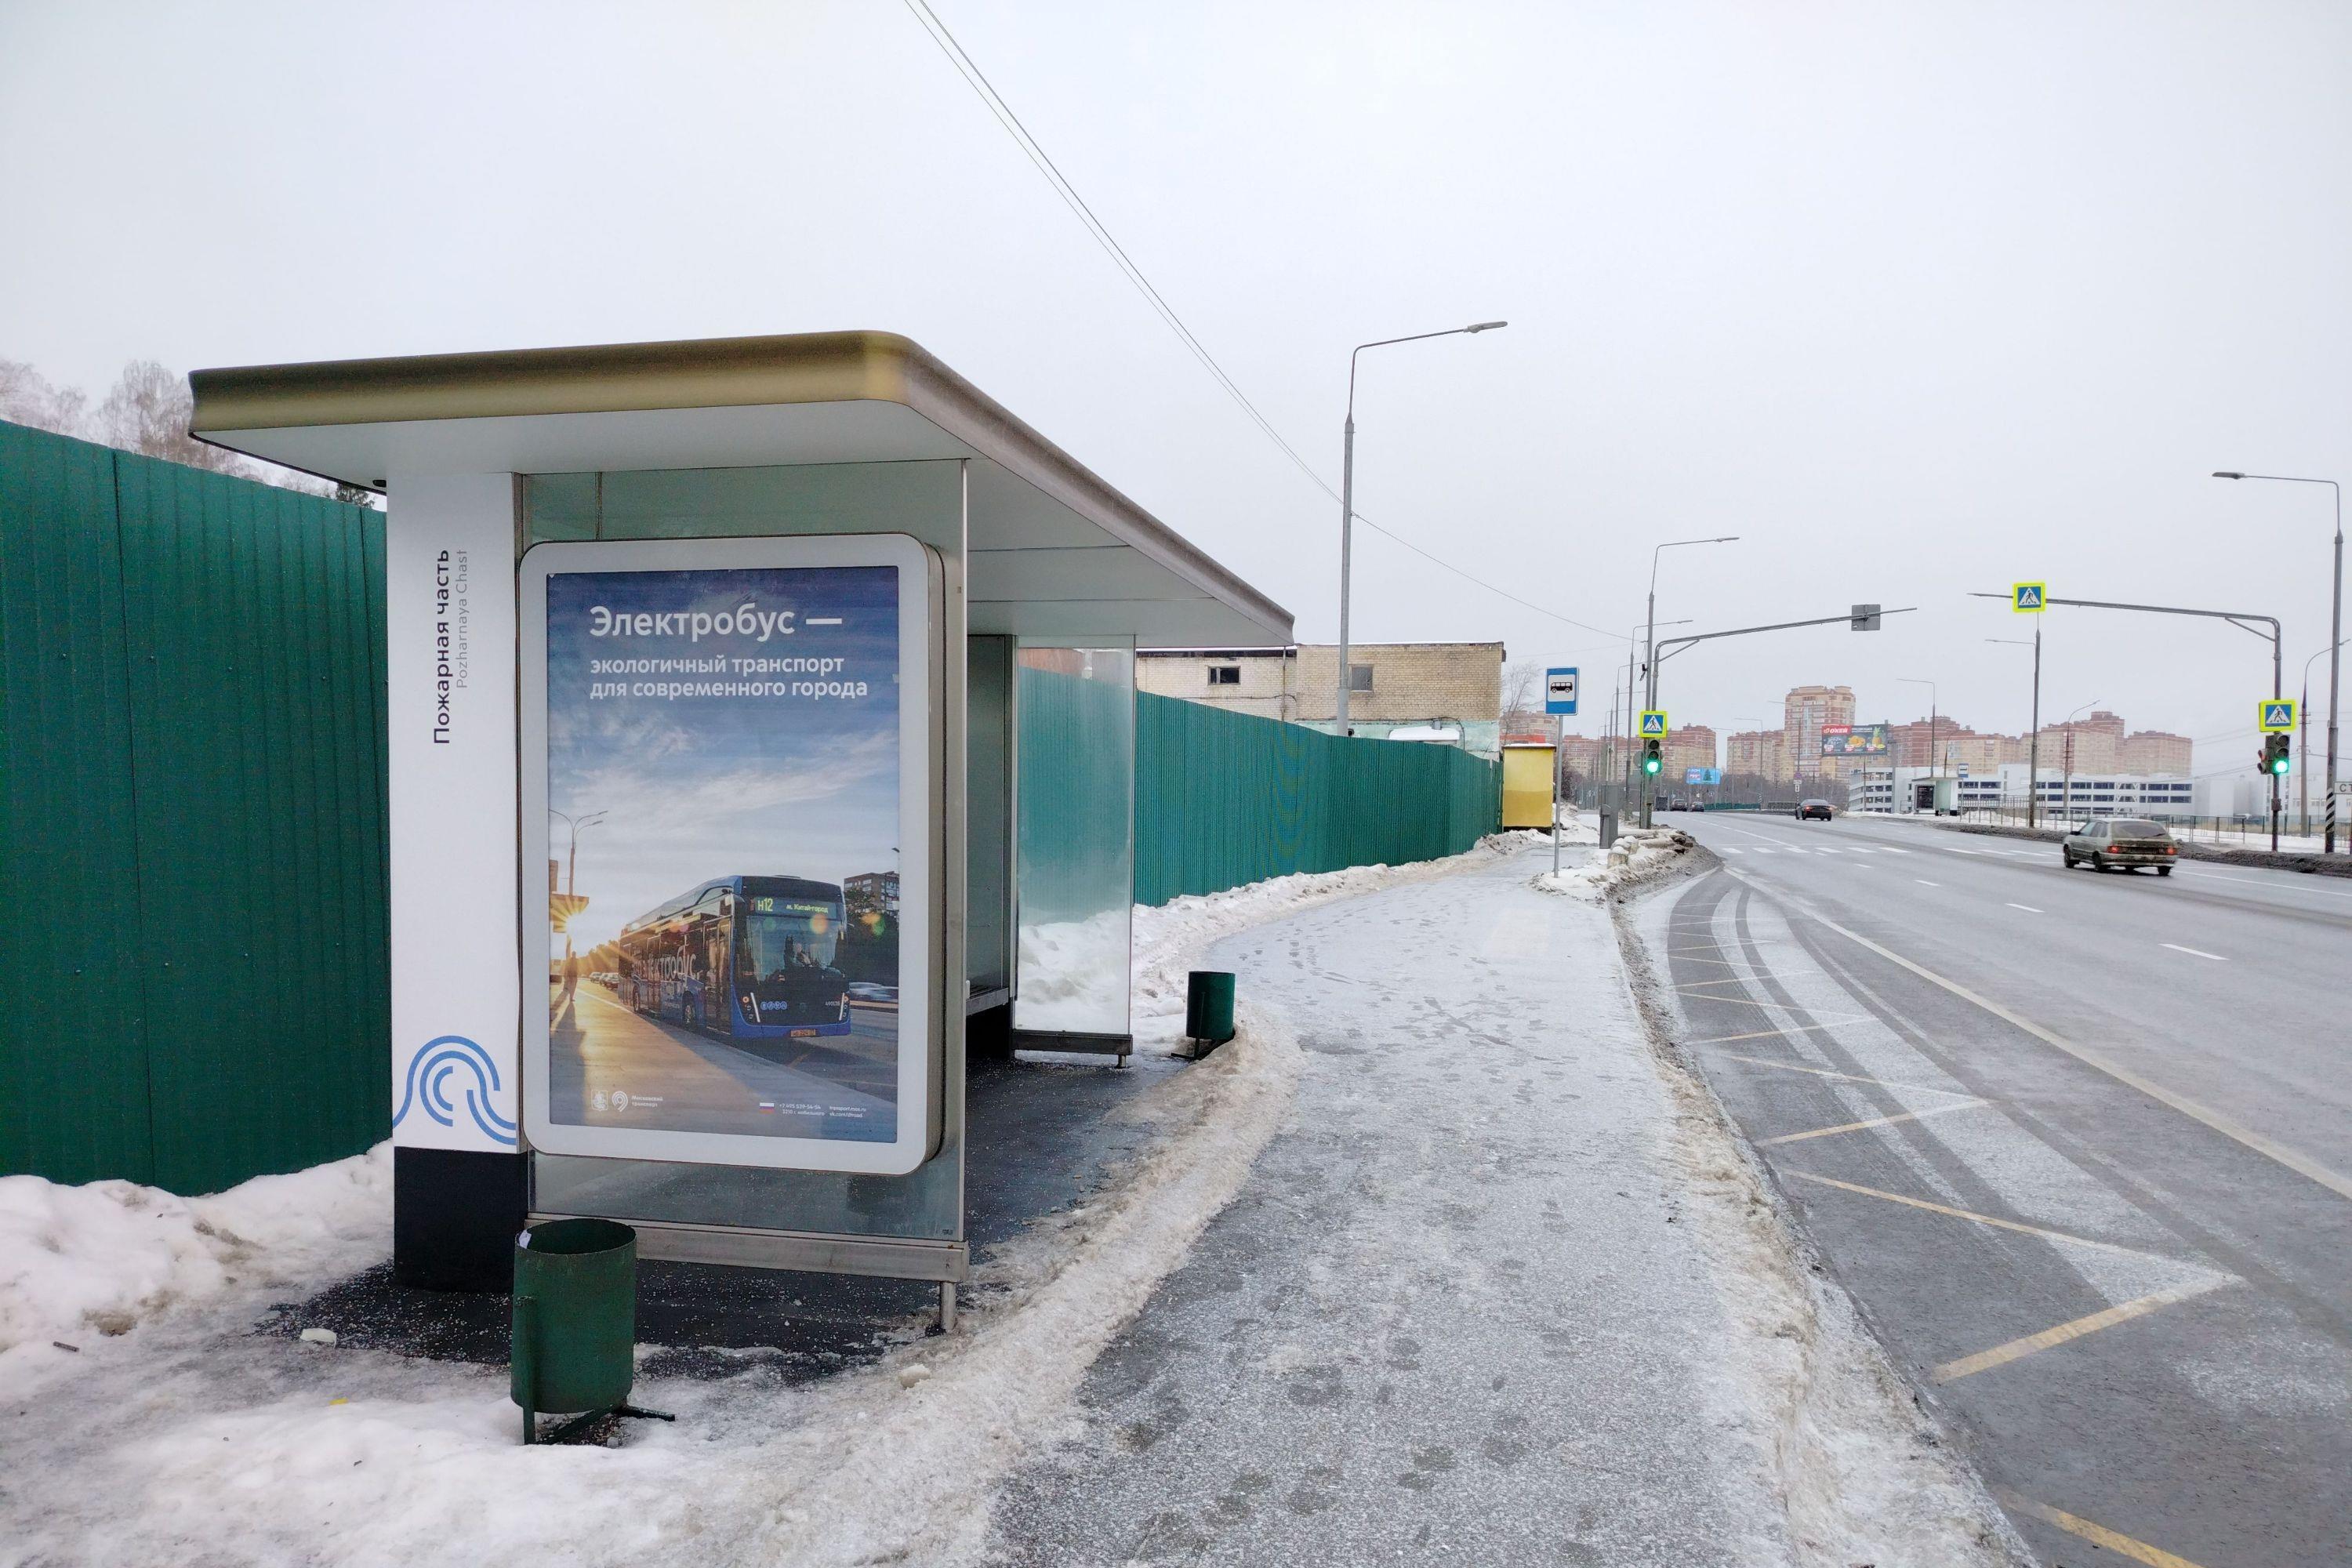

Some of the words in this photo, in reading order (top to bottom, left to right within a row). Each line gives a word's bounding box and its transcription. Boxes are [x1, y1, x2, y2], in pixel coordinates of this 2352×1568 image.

[436, 549, 449, 615] часть
[456, 550, 467, 594] Chast
[456, 597, 470, 688] Pozharnaya
[590, 602, 796, 642] Электробус
[434, 622, 452, 744] Пожарная
[590, 654, 726, 673] экологичный
[731, 657, 844, 677] транспорт
[590, 682, 627, 699] для
[633, 681, 786, 700] современного
[792, 681, 868, 701] города
